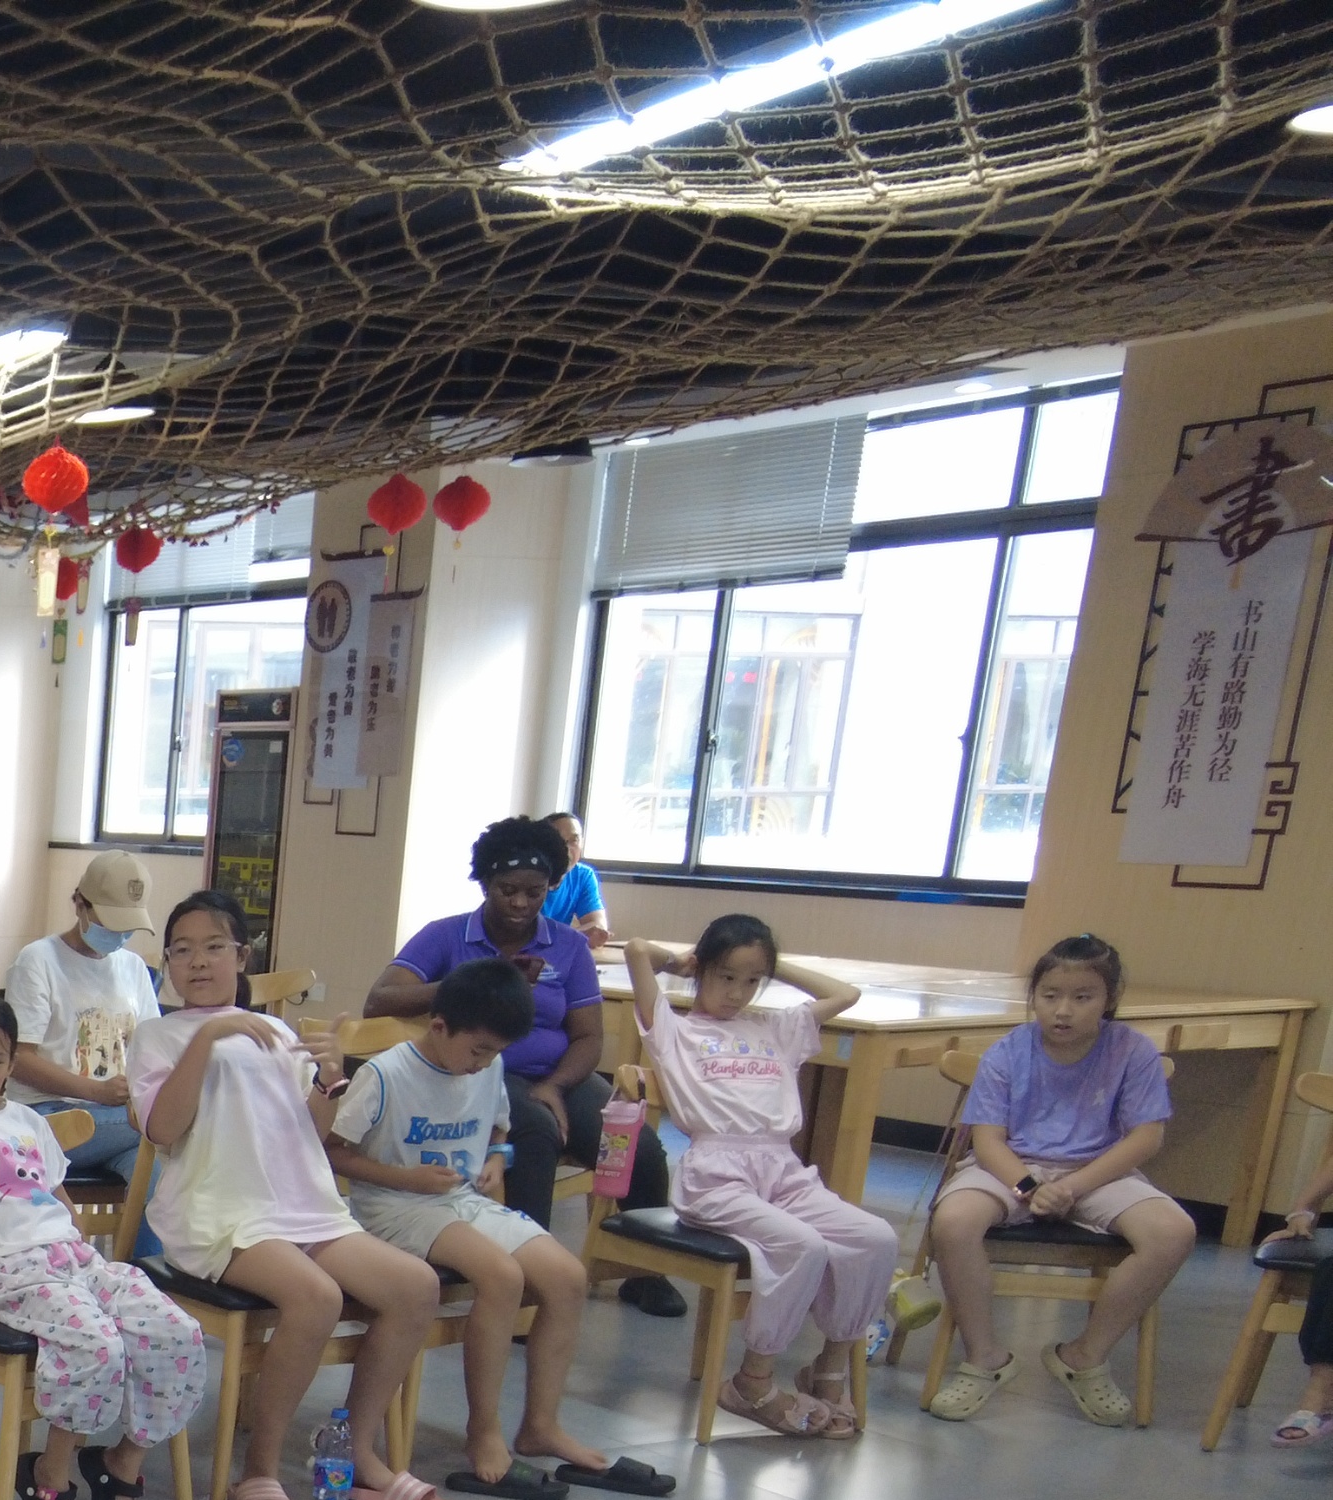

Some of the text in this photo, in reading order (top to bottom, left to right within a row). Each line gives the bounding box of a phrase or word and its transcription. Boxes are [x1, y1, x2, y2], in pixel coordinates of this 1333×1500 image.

[1162, 630, 1216, 809] 学海无涯苦作舟
[1208, 599, 1264, 783] 书山有路勤为径
